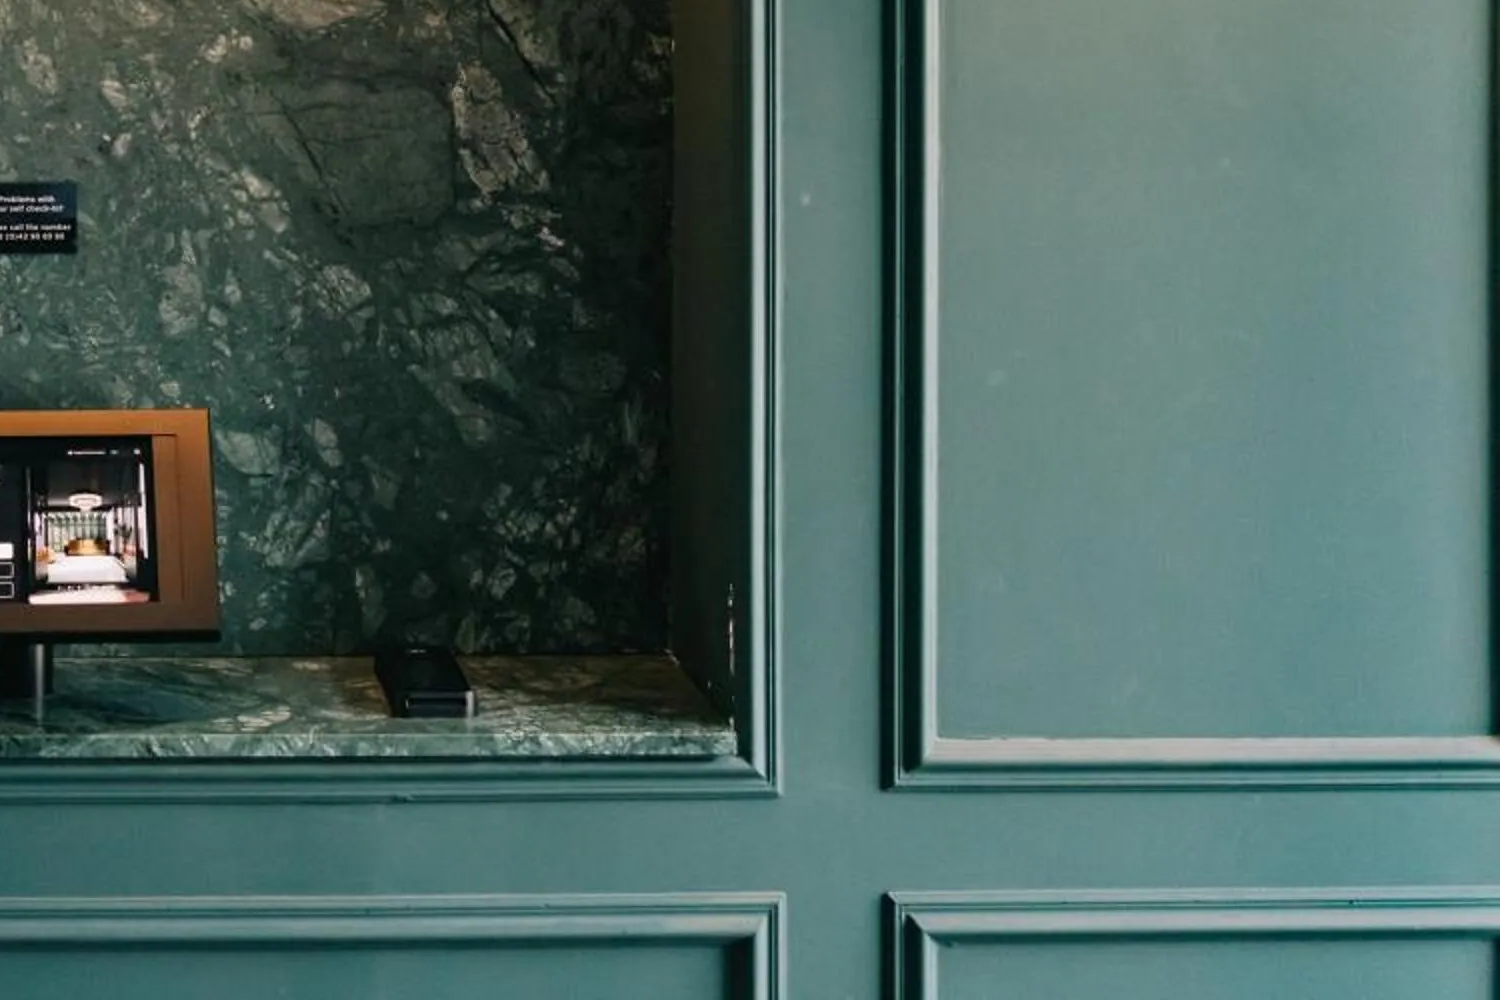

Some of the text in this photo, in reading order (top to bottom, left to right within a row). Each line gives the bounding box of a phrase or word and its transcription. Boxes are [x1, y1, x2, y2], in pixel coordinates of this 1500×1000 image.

[37, 195, 55, 203] with
[9, 205, 25, 213] self
[9, 223, 25, 231] call
[25, 223, 39, 231] the
[40, 223, 71, 231] number
